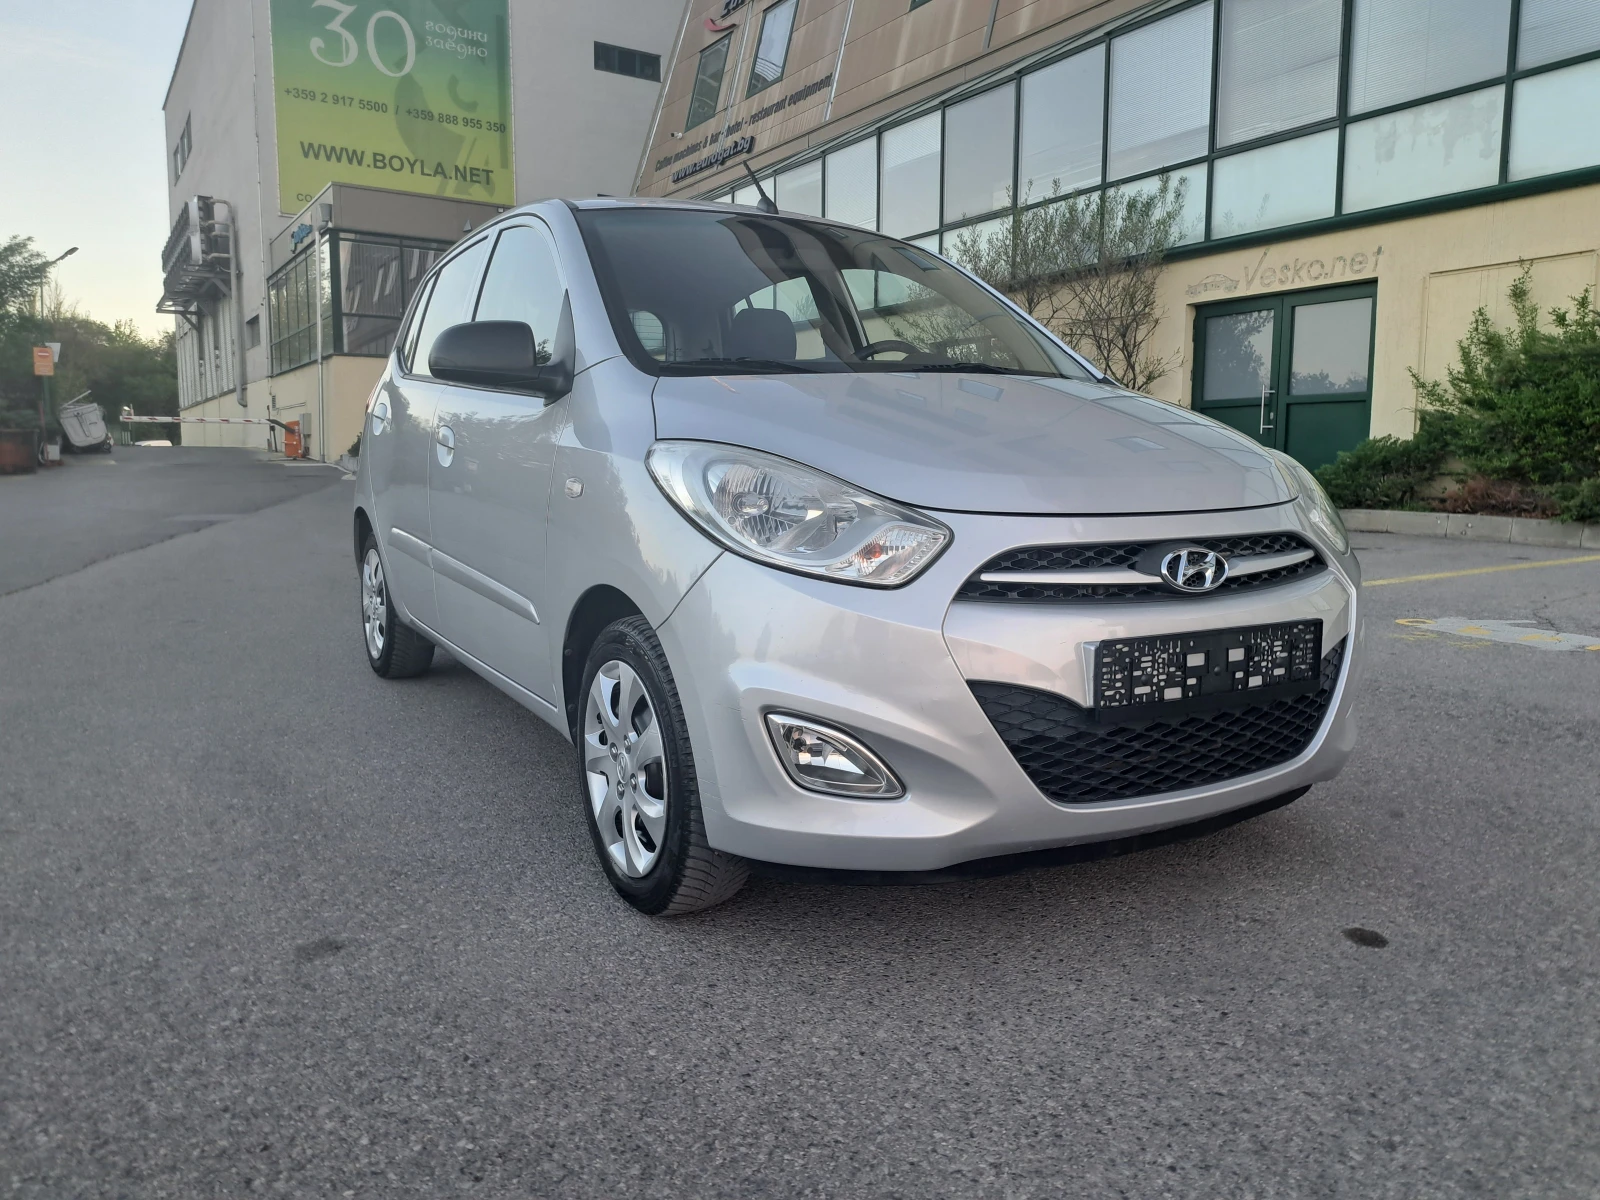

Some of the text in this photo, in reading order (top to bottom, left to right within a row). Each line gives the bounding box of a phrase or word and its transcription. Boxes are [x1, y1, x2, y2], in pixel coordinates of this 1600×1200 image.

[309, 0, 416, 78] 30
[284, 87, 316, 101] +359
[320, 92, 328, 104] 2
[332, 94, 354, 108] 917
[358, 99, 388, 114] 5500
[406, 108, 434, 121] +359
[438, 112, 459, 126] 888
[462, 116, 483, 130] 955
[485, 121, 506, 134] 350
[748, 95, 788, 126] restaurant
[787, 72, 834, 107] equipment
[300, 140, 494, 186] WWW.BOYLA.NET
[672, 135, 754, 183] www.eurogat.bg
[296, 193, 314, 203] CO
[1243, 245, 1384, 292] Vesko.net
